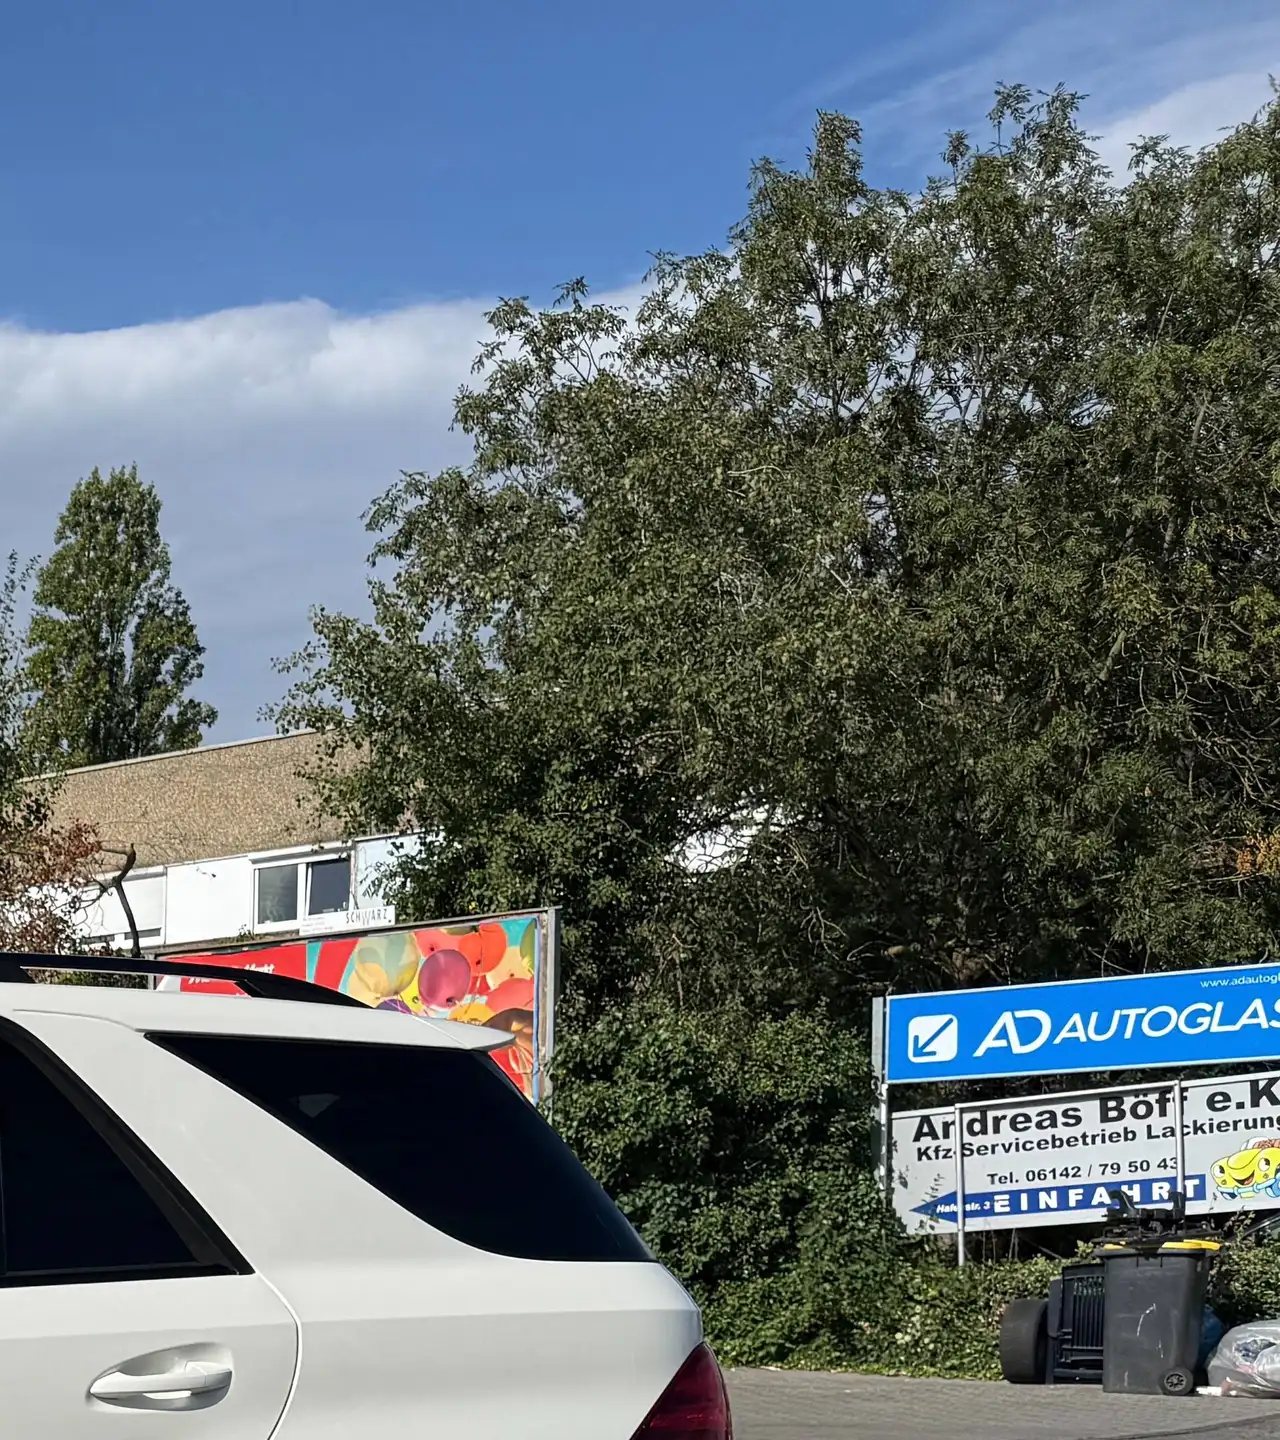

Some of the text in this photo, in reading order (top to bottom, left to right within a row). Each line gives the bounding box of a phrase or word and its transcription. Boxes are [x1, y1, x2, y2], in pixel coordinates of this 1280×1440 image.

[345, 908, 387, 926] SCHWARZ
[972, 1008, 1052, 1057] AD
[987, 1171, 1019, 1185] Tel.
[1026, 1165, 1082, 1182] 06142
[1098, 1162, 1121, 1176] 79
[1128, 1159, 1150, 1173] 50
[993, 1178, 1200, 1213] EINFAHRT
